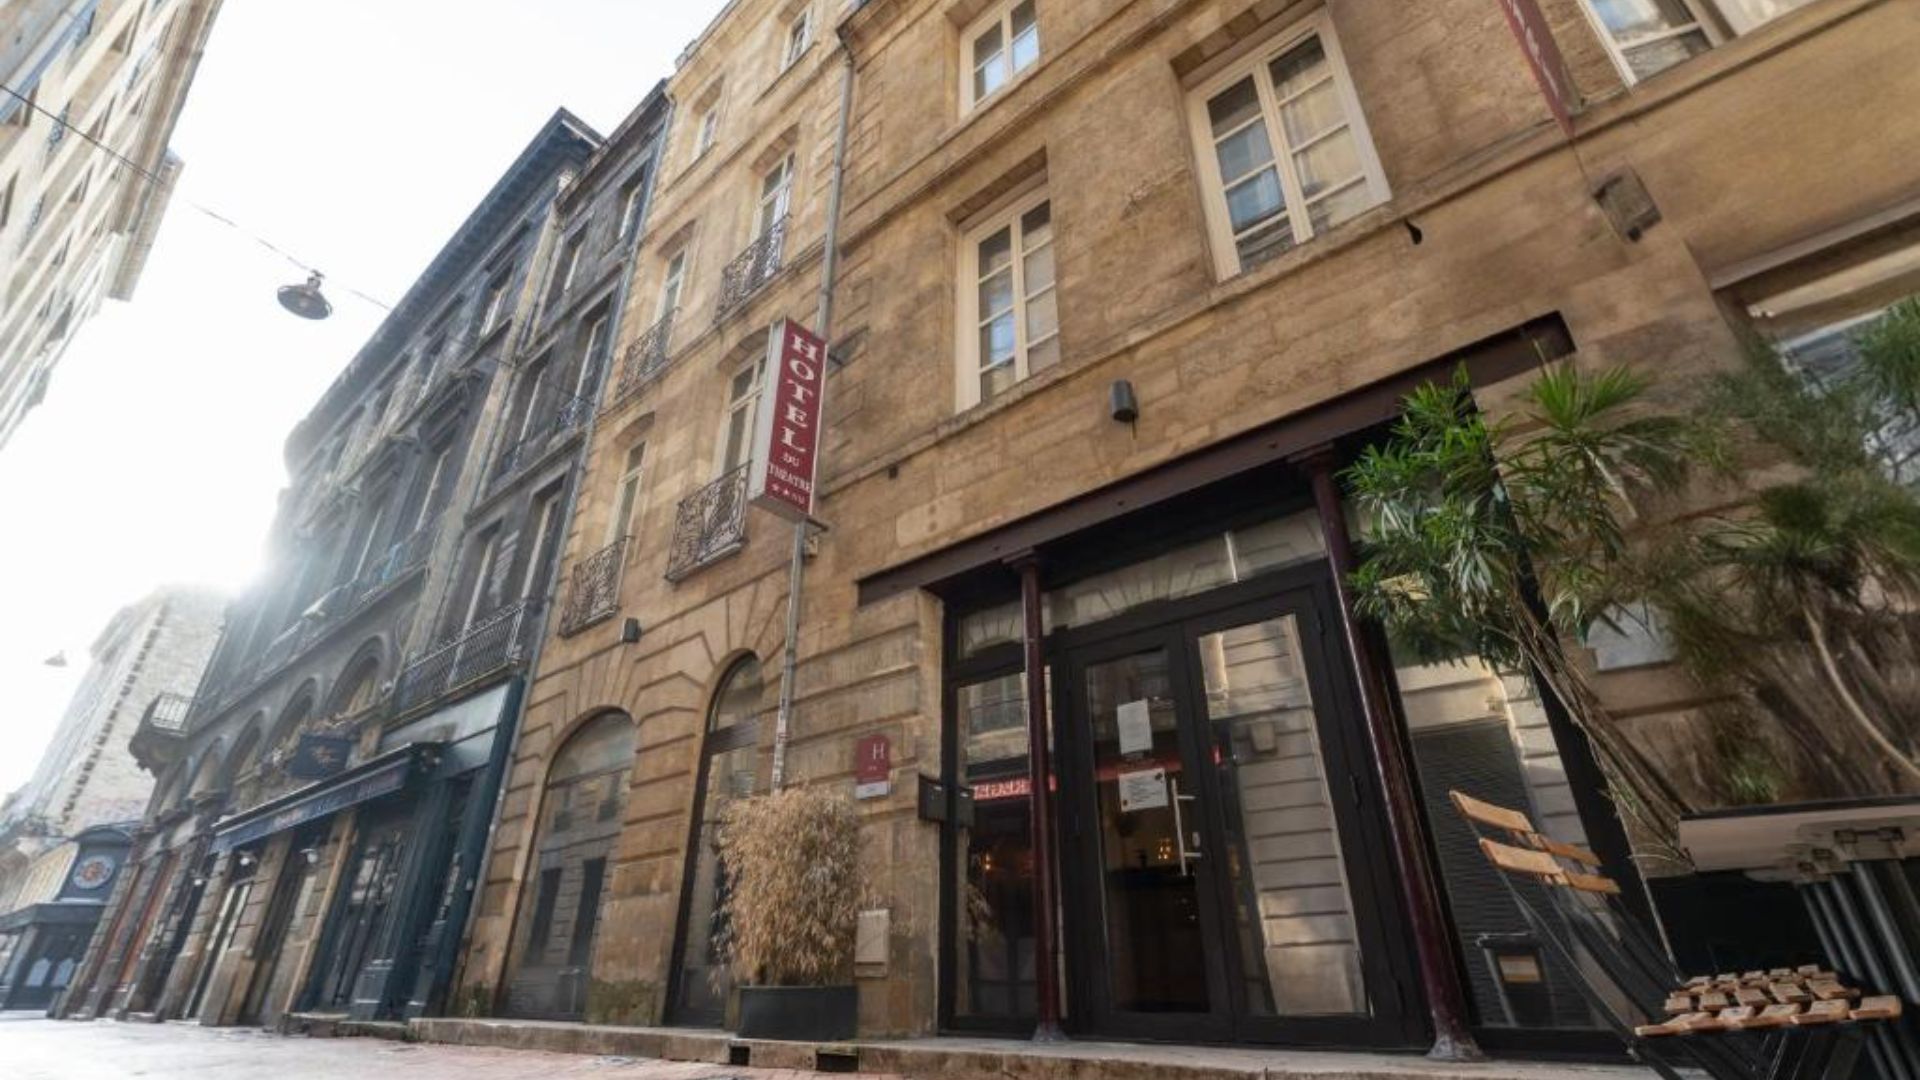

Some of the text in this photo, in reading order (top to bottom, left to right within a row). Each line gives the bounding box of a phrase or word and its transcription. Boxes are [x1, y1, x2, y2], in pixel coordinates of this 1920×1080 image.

[781, 333, 818, 453] HOTEL
[782, 452, 800, 468] DU
[872, 743, 885, 760] H
